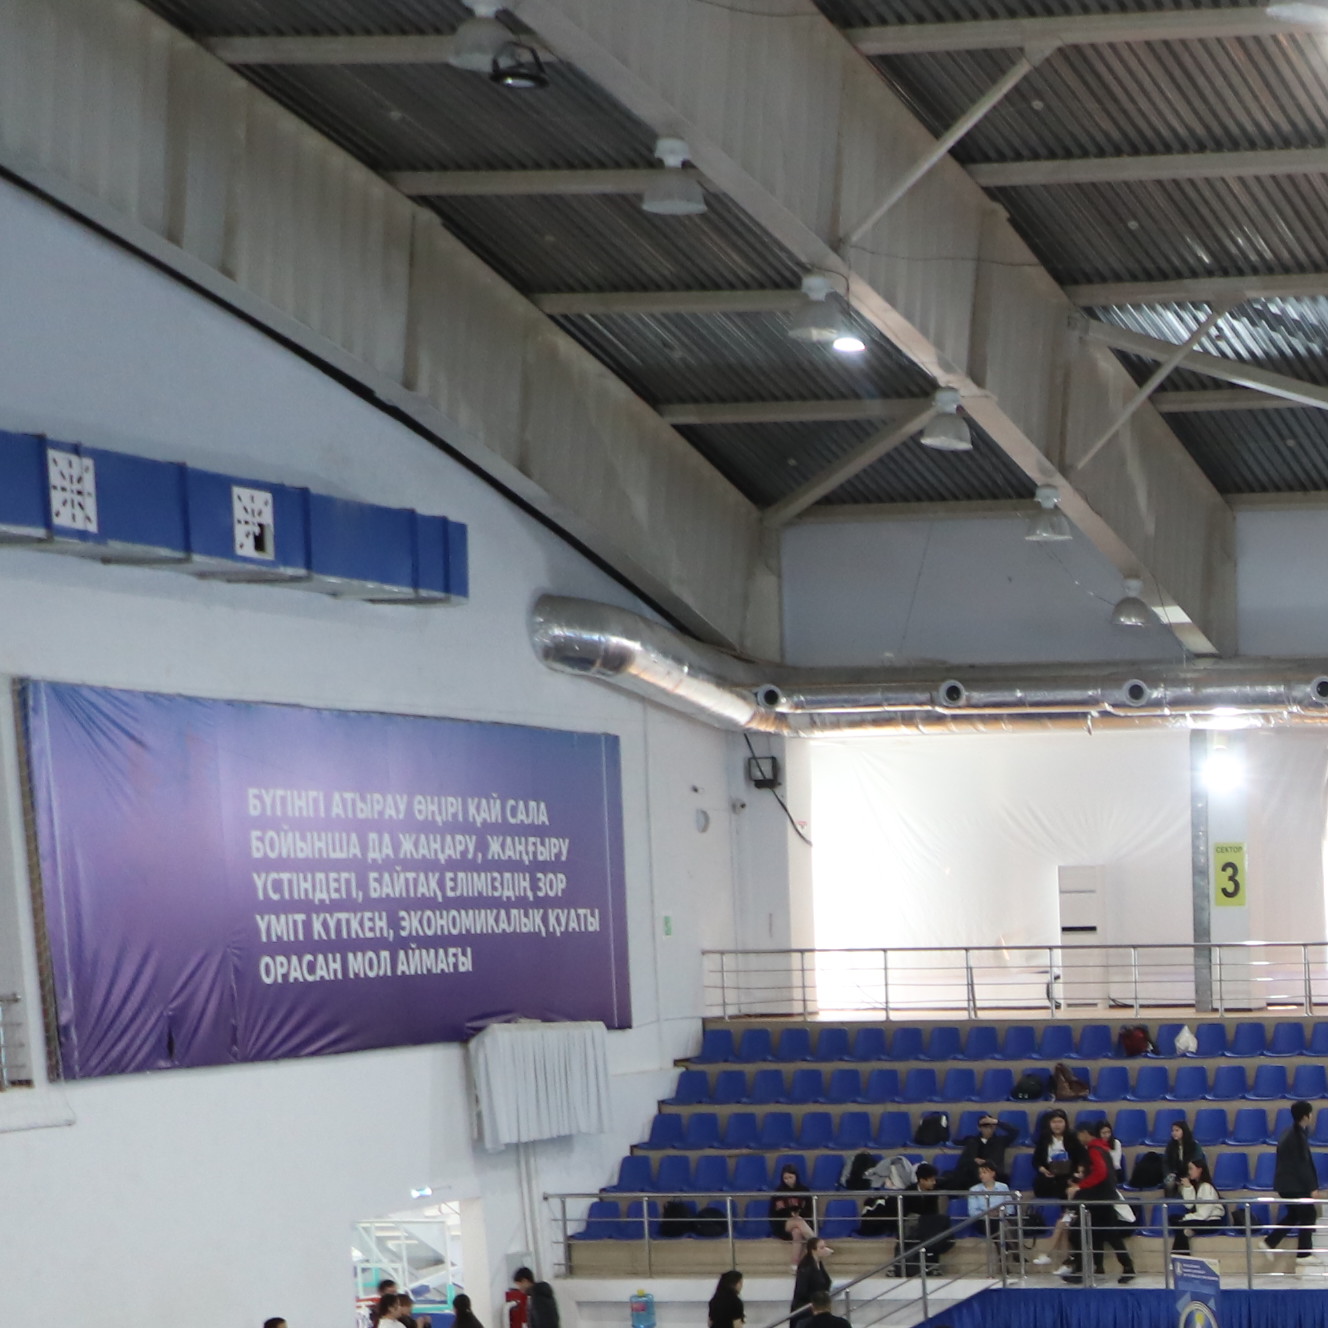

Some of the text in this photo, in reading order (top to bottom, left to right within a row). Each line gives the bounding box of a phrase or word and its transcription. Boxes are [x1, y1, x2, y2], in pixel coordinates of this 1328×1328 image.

[248, 788, 549, 827] БҮГІНГІ АТЫРАУ ӨҢІРІ ҚАЙ САЛА
[250, 824, 570, 865] БОЙЫНША ДА ЖАҢАРУ, ЖАҢҒЫРУ
[252, 866, 567, 904] ҮСТІНДЕГІ, БАЙТАҚ ЕЛІМІЗДІҢ ЗОР
[1220, 862, 1240, 898] 3
[255, 908, 600, 942] ҮМІТ КҮТКЕН, ЭКОНОМИКАЛЫҚ ҚУАТЫ
[259, 943, 473, 985] ОРАСАН МОЛ АЙМАҒЫ
